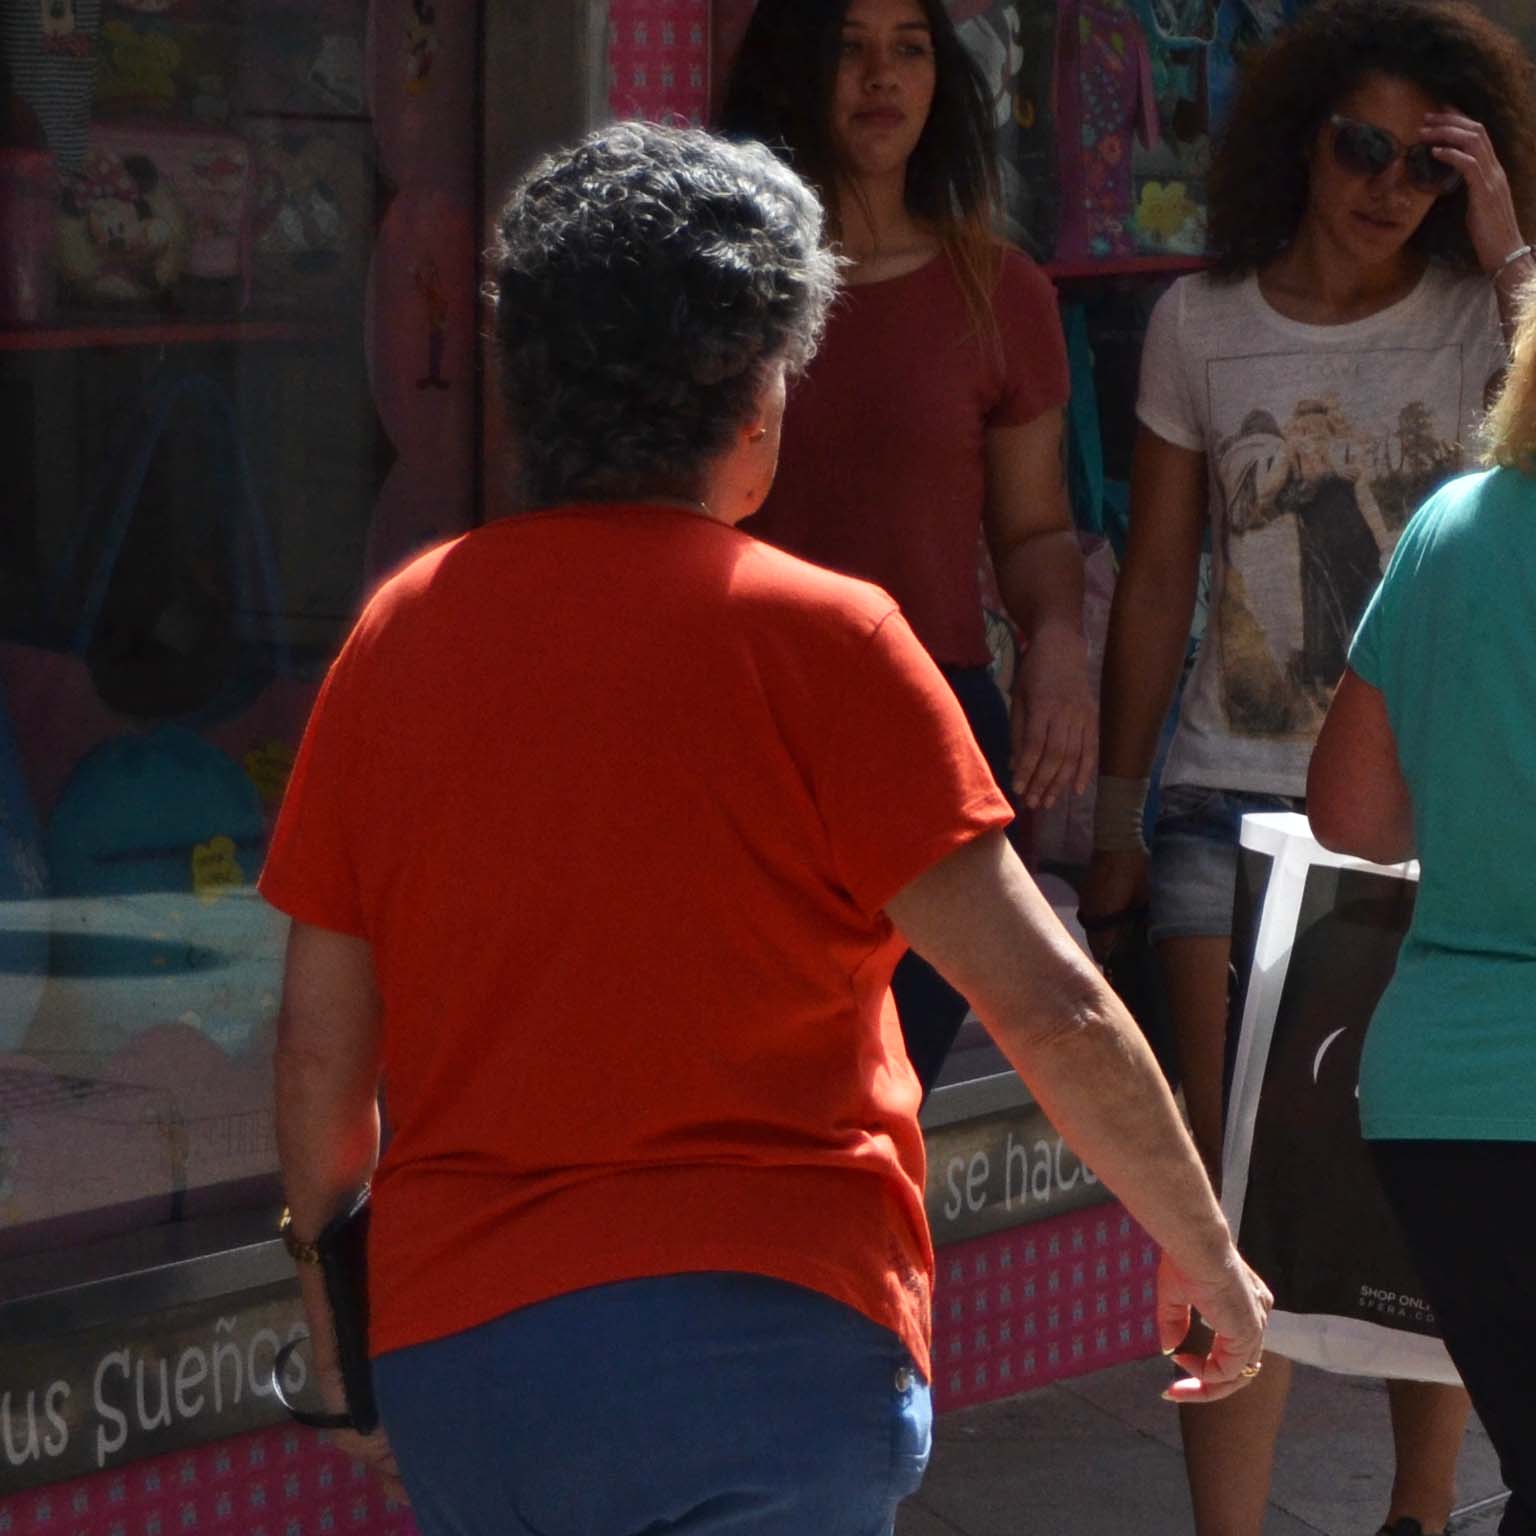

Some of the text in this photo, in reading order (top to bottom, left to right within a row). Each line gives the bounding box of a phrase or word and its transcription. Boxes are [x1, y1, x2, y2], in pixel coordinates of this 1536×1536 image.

[943, 1151, 990, 1221] se
[1360, 1284, 1396, 1303] SHOP
[93, 1315, 312, 1468] Sueños
